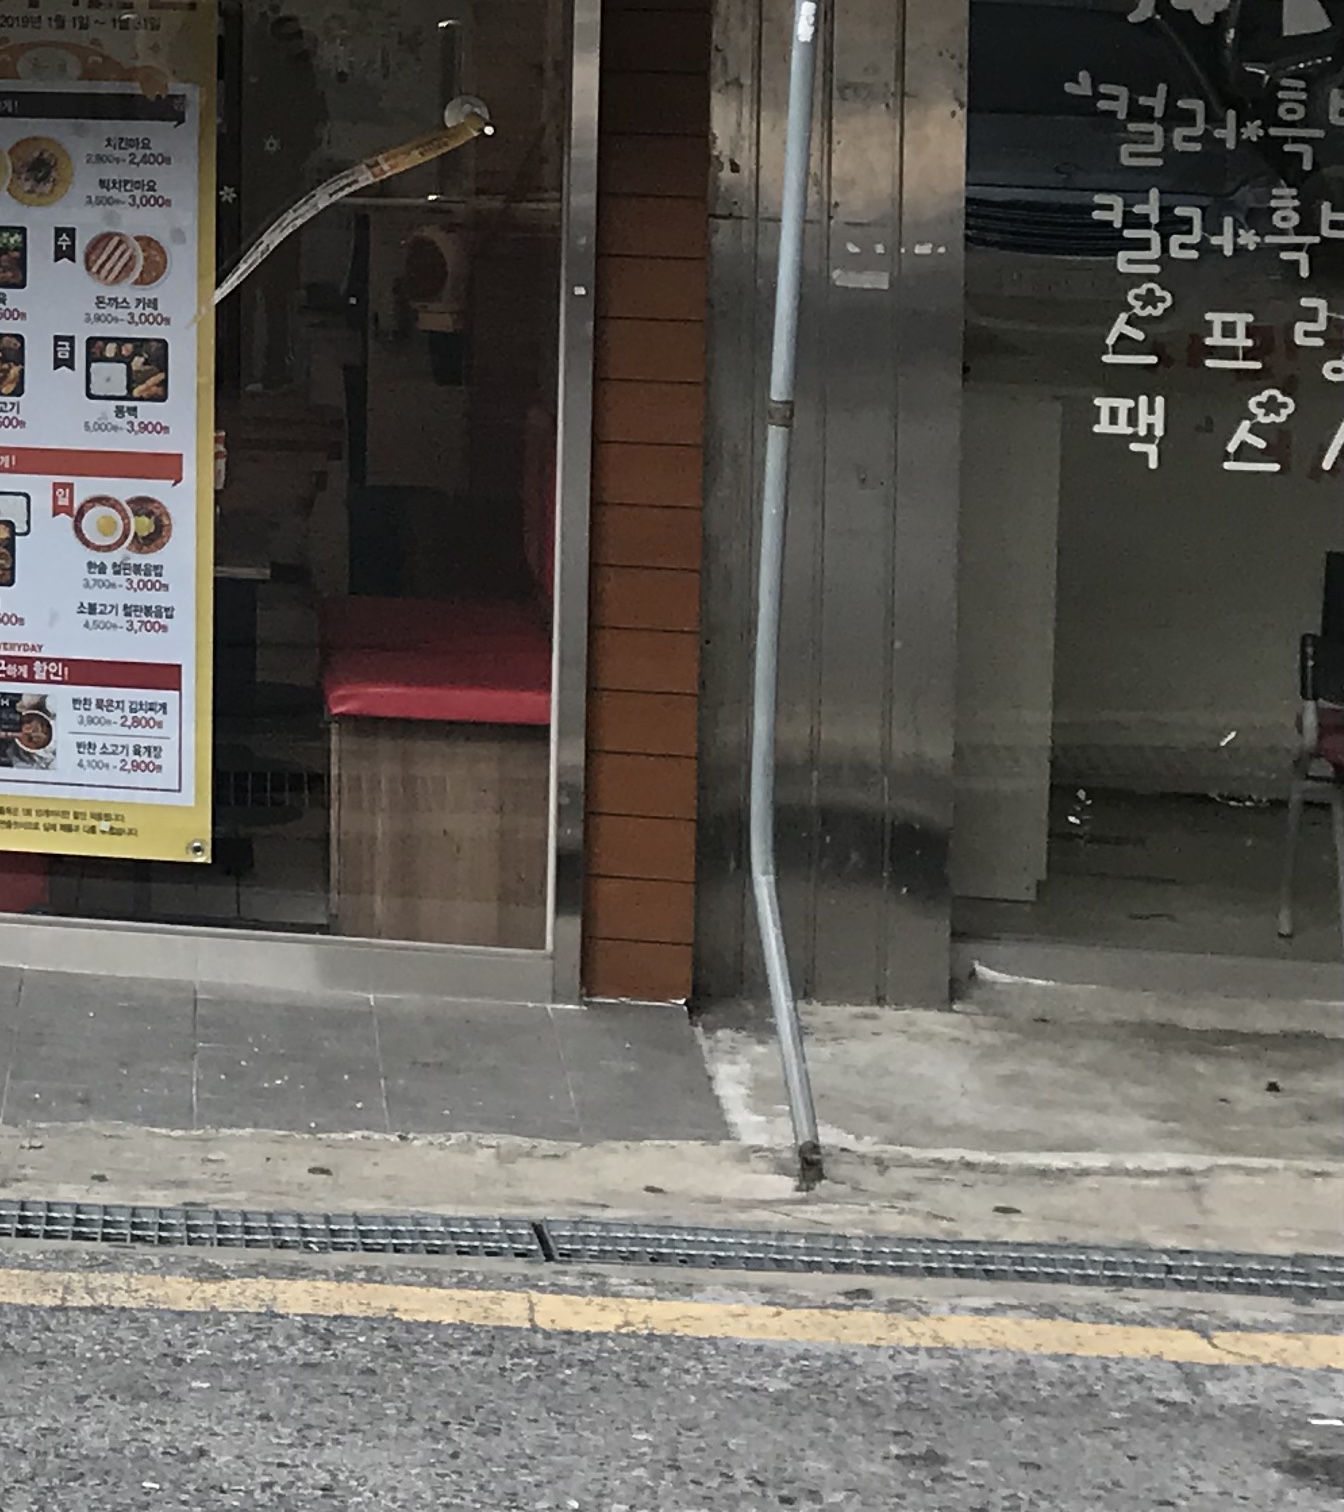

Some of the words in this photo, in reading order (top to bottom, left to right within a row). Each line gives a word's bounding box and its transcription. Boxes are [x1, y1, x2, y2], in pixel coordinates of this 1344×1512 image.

[104, 135, 153, 152] 치킨마요
[55, 233, 73, 251] 수
[93, 294, 131, 310] 돈까스
[134, 295, 159, 311] 카레
[56, 340, 70, 360] 금
[54, 487, 70, 506] 일
[75, 600, 120, 617] 소불고기
[71, 696, 93, 713] 반찬
[75, 740, 98, 756] 반찬
[99, 742, 130, 758] 소고기
